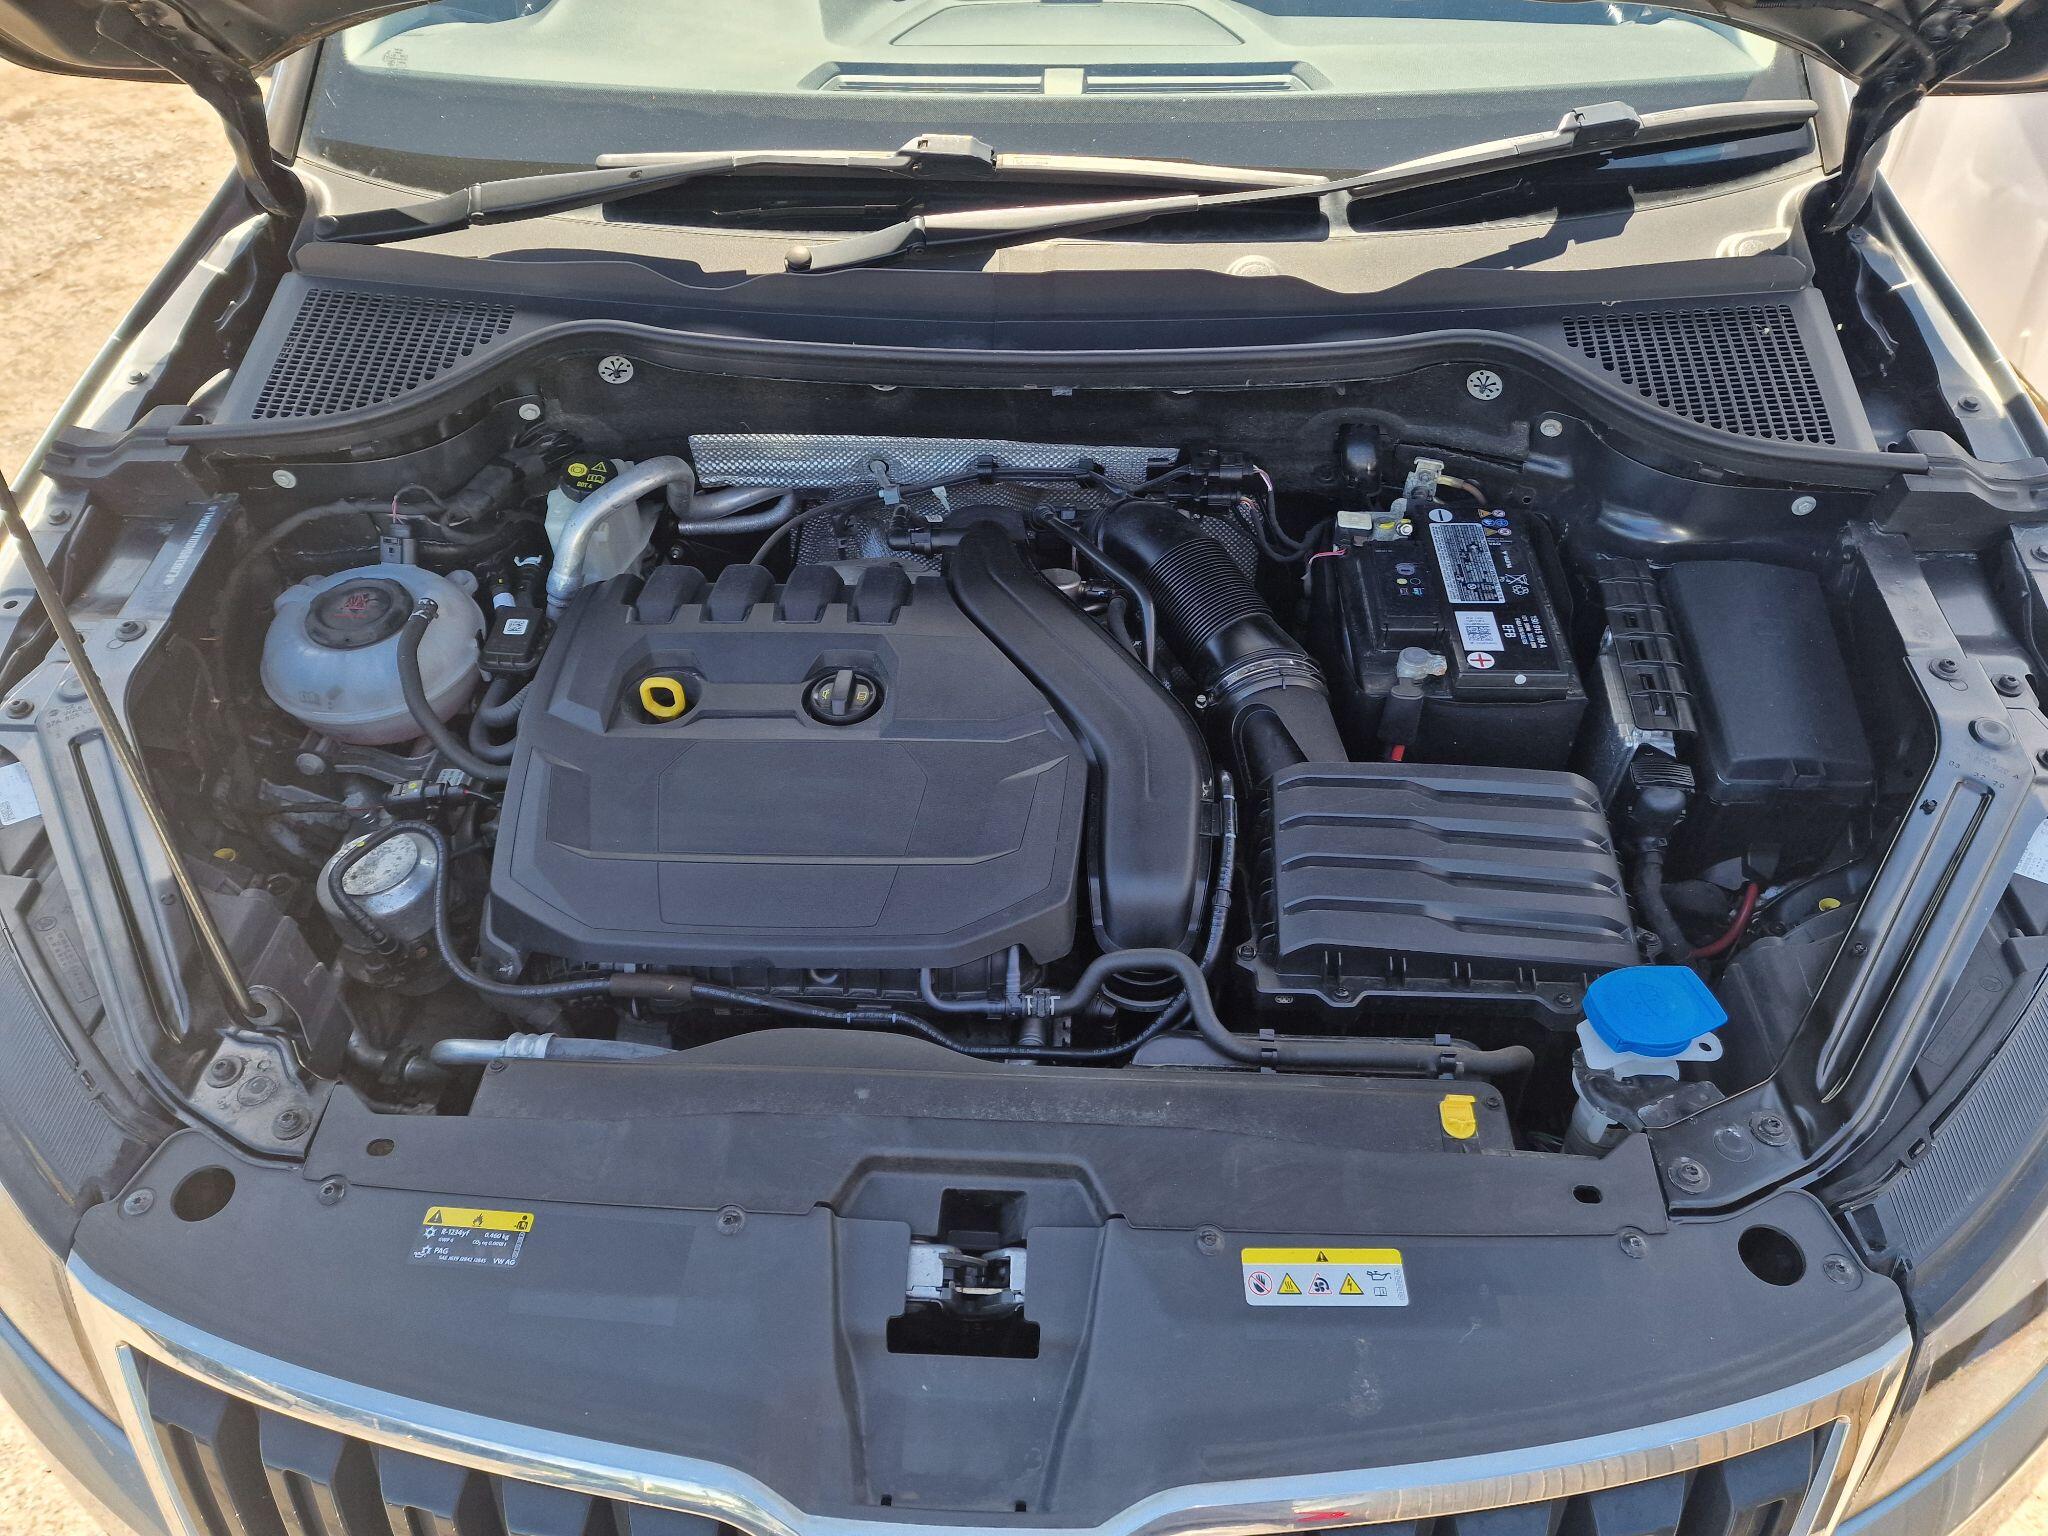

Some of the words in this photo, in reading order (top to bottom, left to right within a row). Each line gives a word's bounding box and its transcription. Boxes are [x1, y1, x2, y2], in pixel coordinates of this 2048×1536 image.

[1502, 624, 1517, 638] EFB
[1533, 624, 1543, 634] 915
[441, 1228, 470, 1237] R-1234yf
[434, 1246, 449, 1255] PAG
[493, 1257, 505, 1265] VW
[504, 1258, 516, 1266] AG
